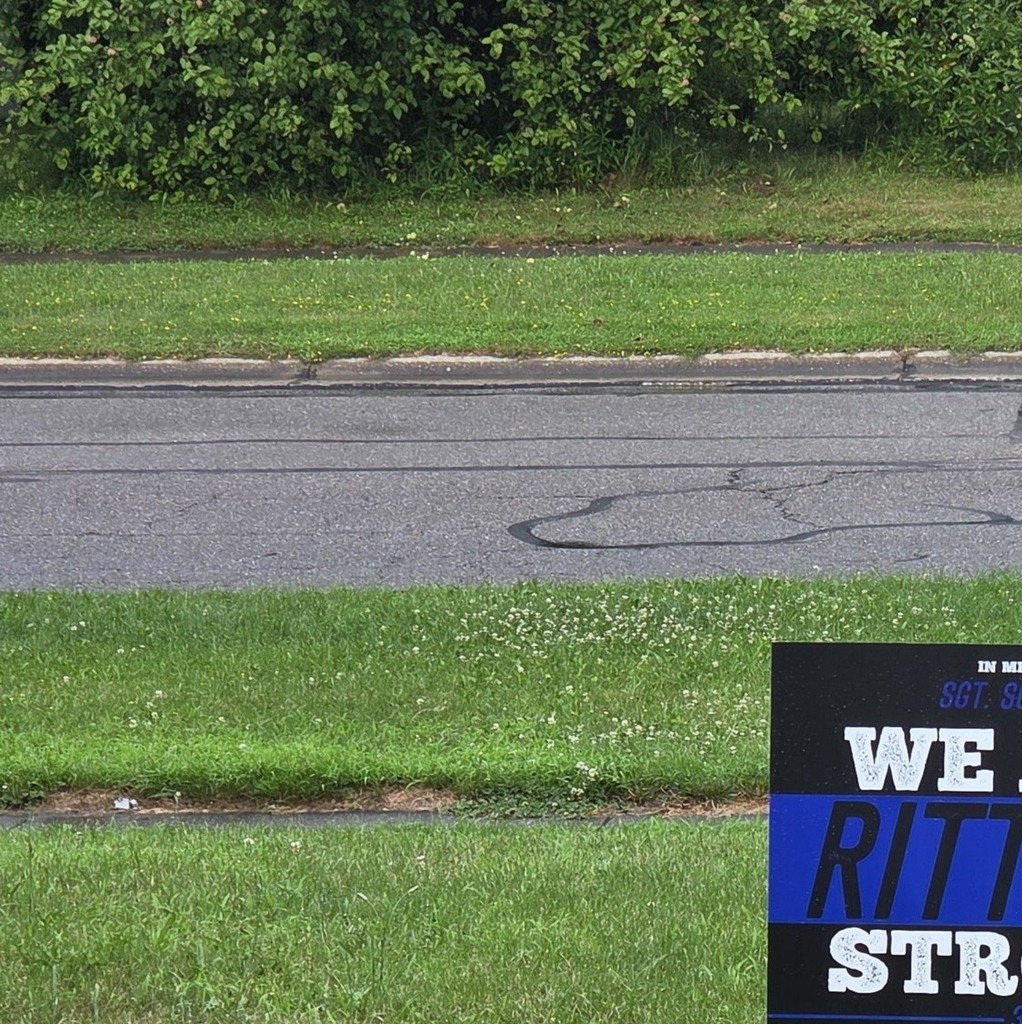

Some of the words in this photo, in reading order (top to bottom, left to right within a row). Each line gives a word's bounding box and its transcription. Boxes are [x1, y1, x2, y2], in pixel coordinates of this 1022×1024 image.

[978, 660, 996, 673] IN
[939, 680, 989, 710] SGT.
[844, 727, 995, 792] WE
